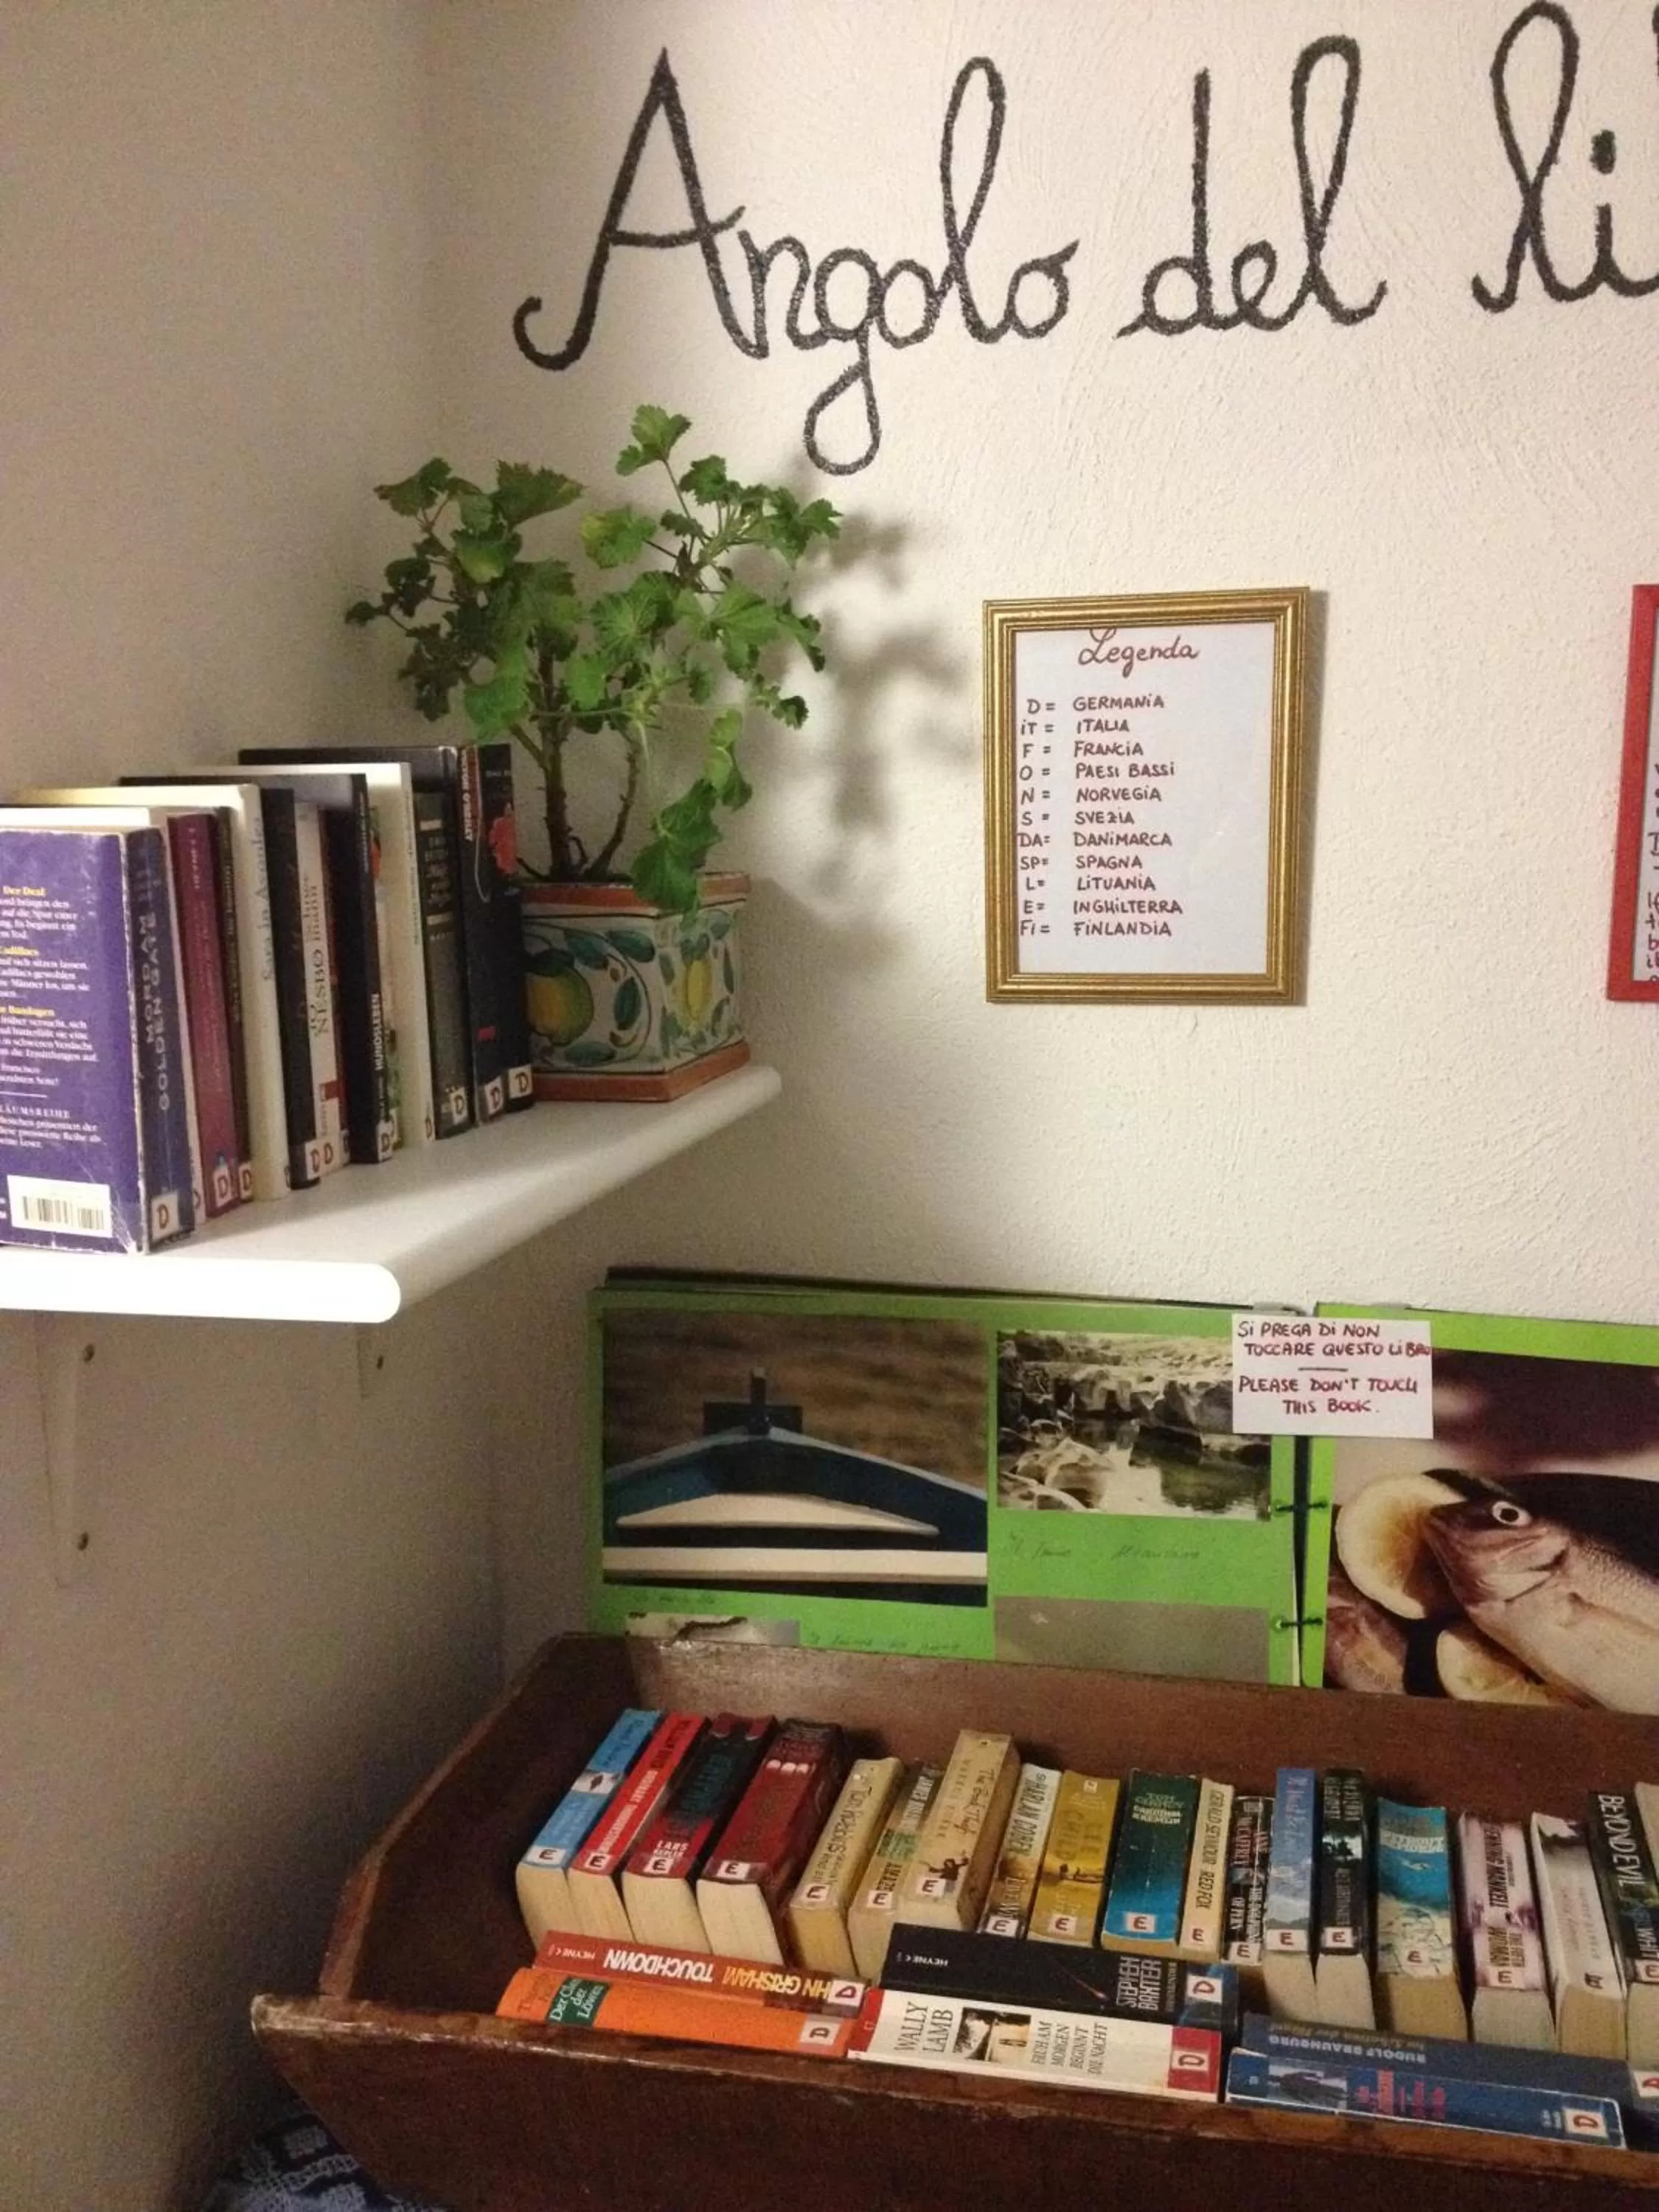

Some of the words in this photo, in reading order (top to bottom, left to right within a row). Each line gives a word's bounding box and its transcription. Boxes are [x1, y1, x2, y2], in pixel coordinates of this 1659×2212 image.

[513, 46, 1080, 476] Angolo
[1115, 34, 1387, 338] del
[1472, 0, 1659, 313] li
[1079, 627, 1199, 678] Legenda
[1077, 718, 1130, 734] ITALIA
[1076, 855, 1142, 870] SPAGNA
[1261, 1323, 1311, 1338] PREGA
[1343, 1324, 1380, 1338] NON
[1244, 1343, 1315, 1357] TOCCARE
[1323, 1343, 1383, 1355] QUESTO
[1239, 1376, 1298, 1393] PLEASE
[1310, 1378, 1360, 1391] DON'T
[1368, 1379, 1417, 1394] TOUCH
[1283, 1400, 1316, 1414] THIS
[1596, 1795, 1635, 1854] BEYOND
[1484, 1863, 1509, 1908] MANKELL
[1611, 1854, 1646, 1889] EVIL
[602, 1948, 714, 1983] TOUCHDOWN
[913, 1955, 949, 1967] HEYNE
[723, 1966, 799, 1994] GRISHAM
[1115, 1956, 1140, 2008] STEPHEN
[1136, 1958, 1162, 2012] BAXTER
[894, 2001, 929, 2054] WALLY
[922, 2008, 954, 2054] LAMB
[1366, 2047, 1426, 2064] RUDOLF
